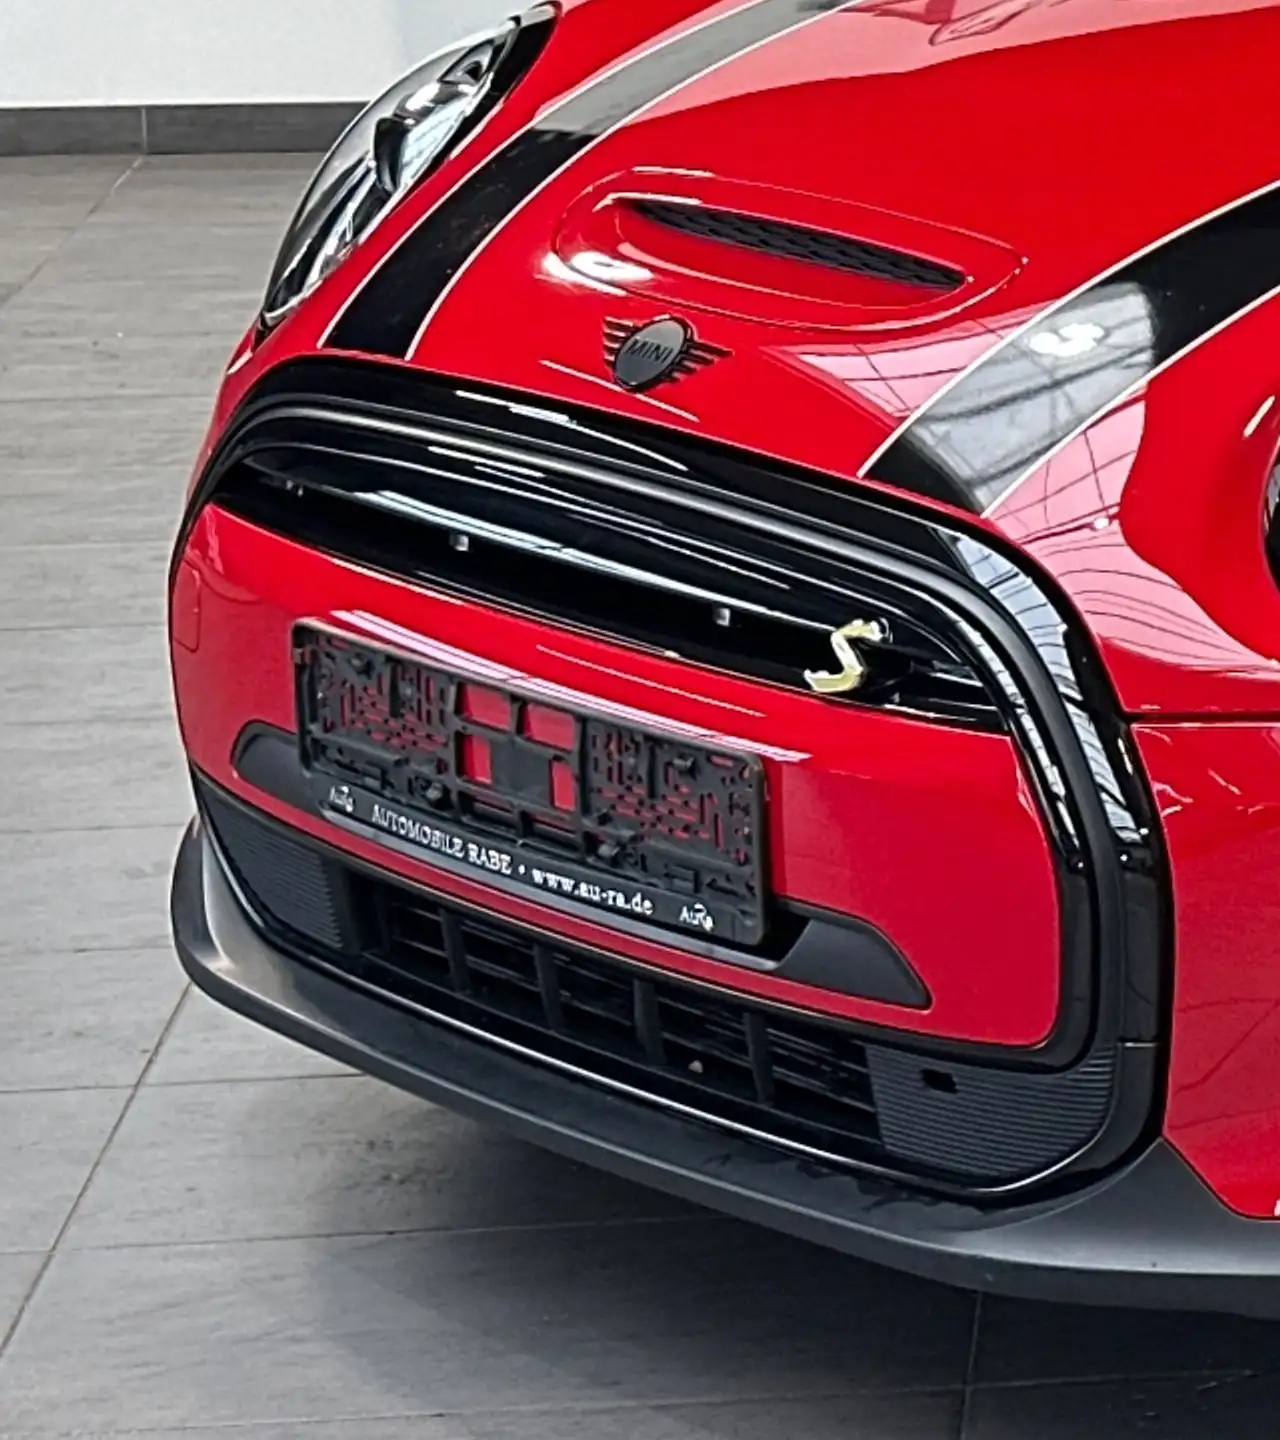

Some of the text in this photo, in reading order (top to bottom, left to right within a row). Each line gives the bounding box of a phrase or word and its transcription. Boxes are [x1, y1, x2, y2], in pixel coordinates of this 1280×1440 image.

[625, 338, 675, 364] MINI
[803, 617, 883, 693] S
[371, 803, 654, 916] AUTOMOBILE RABE www.au-ra.de
